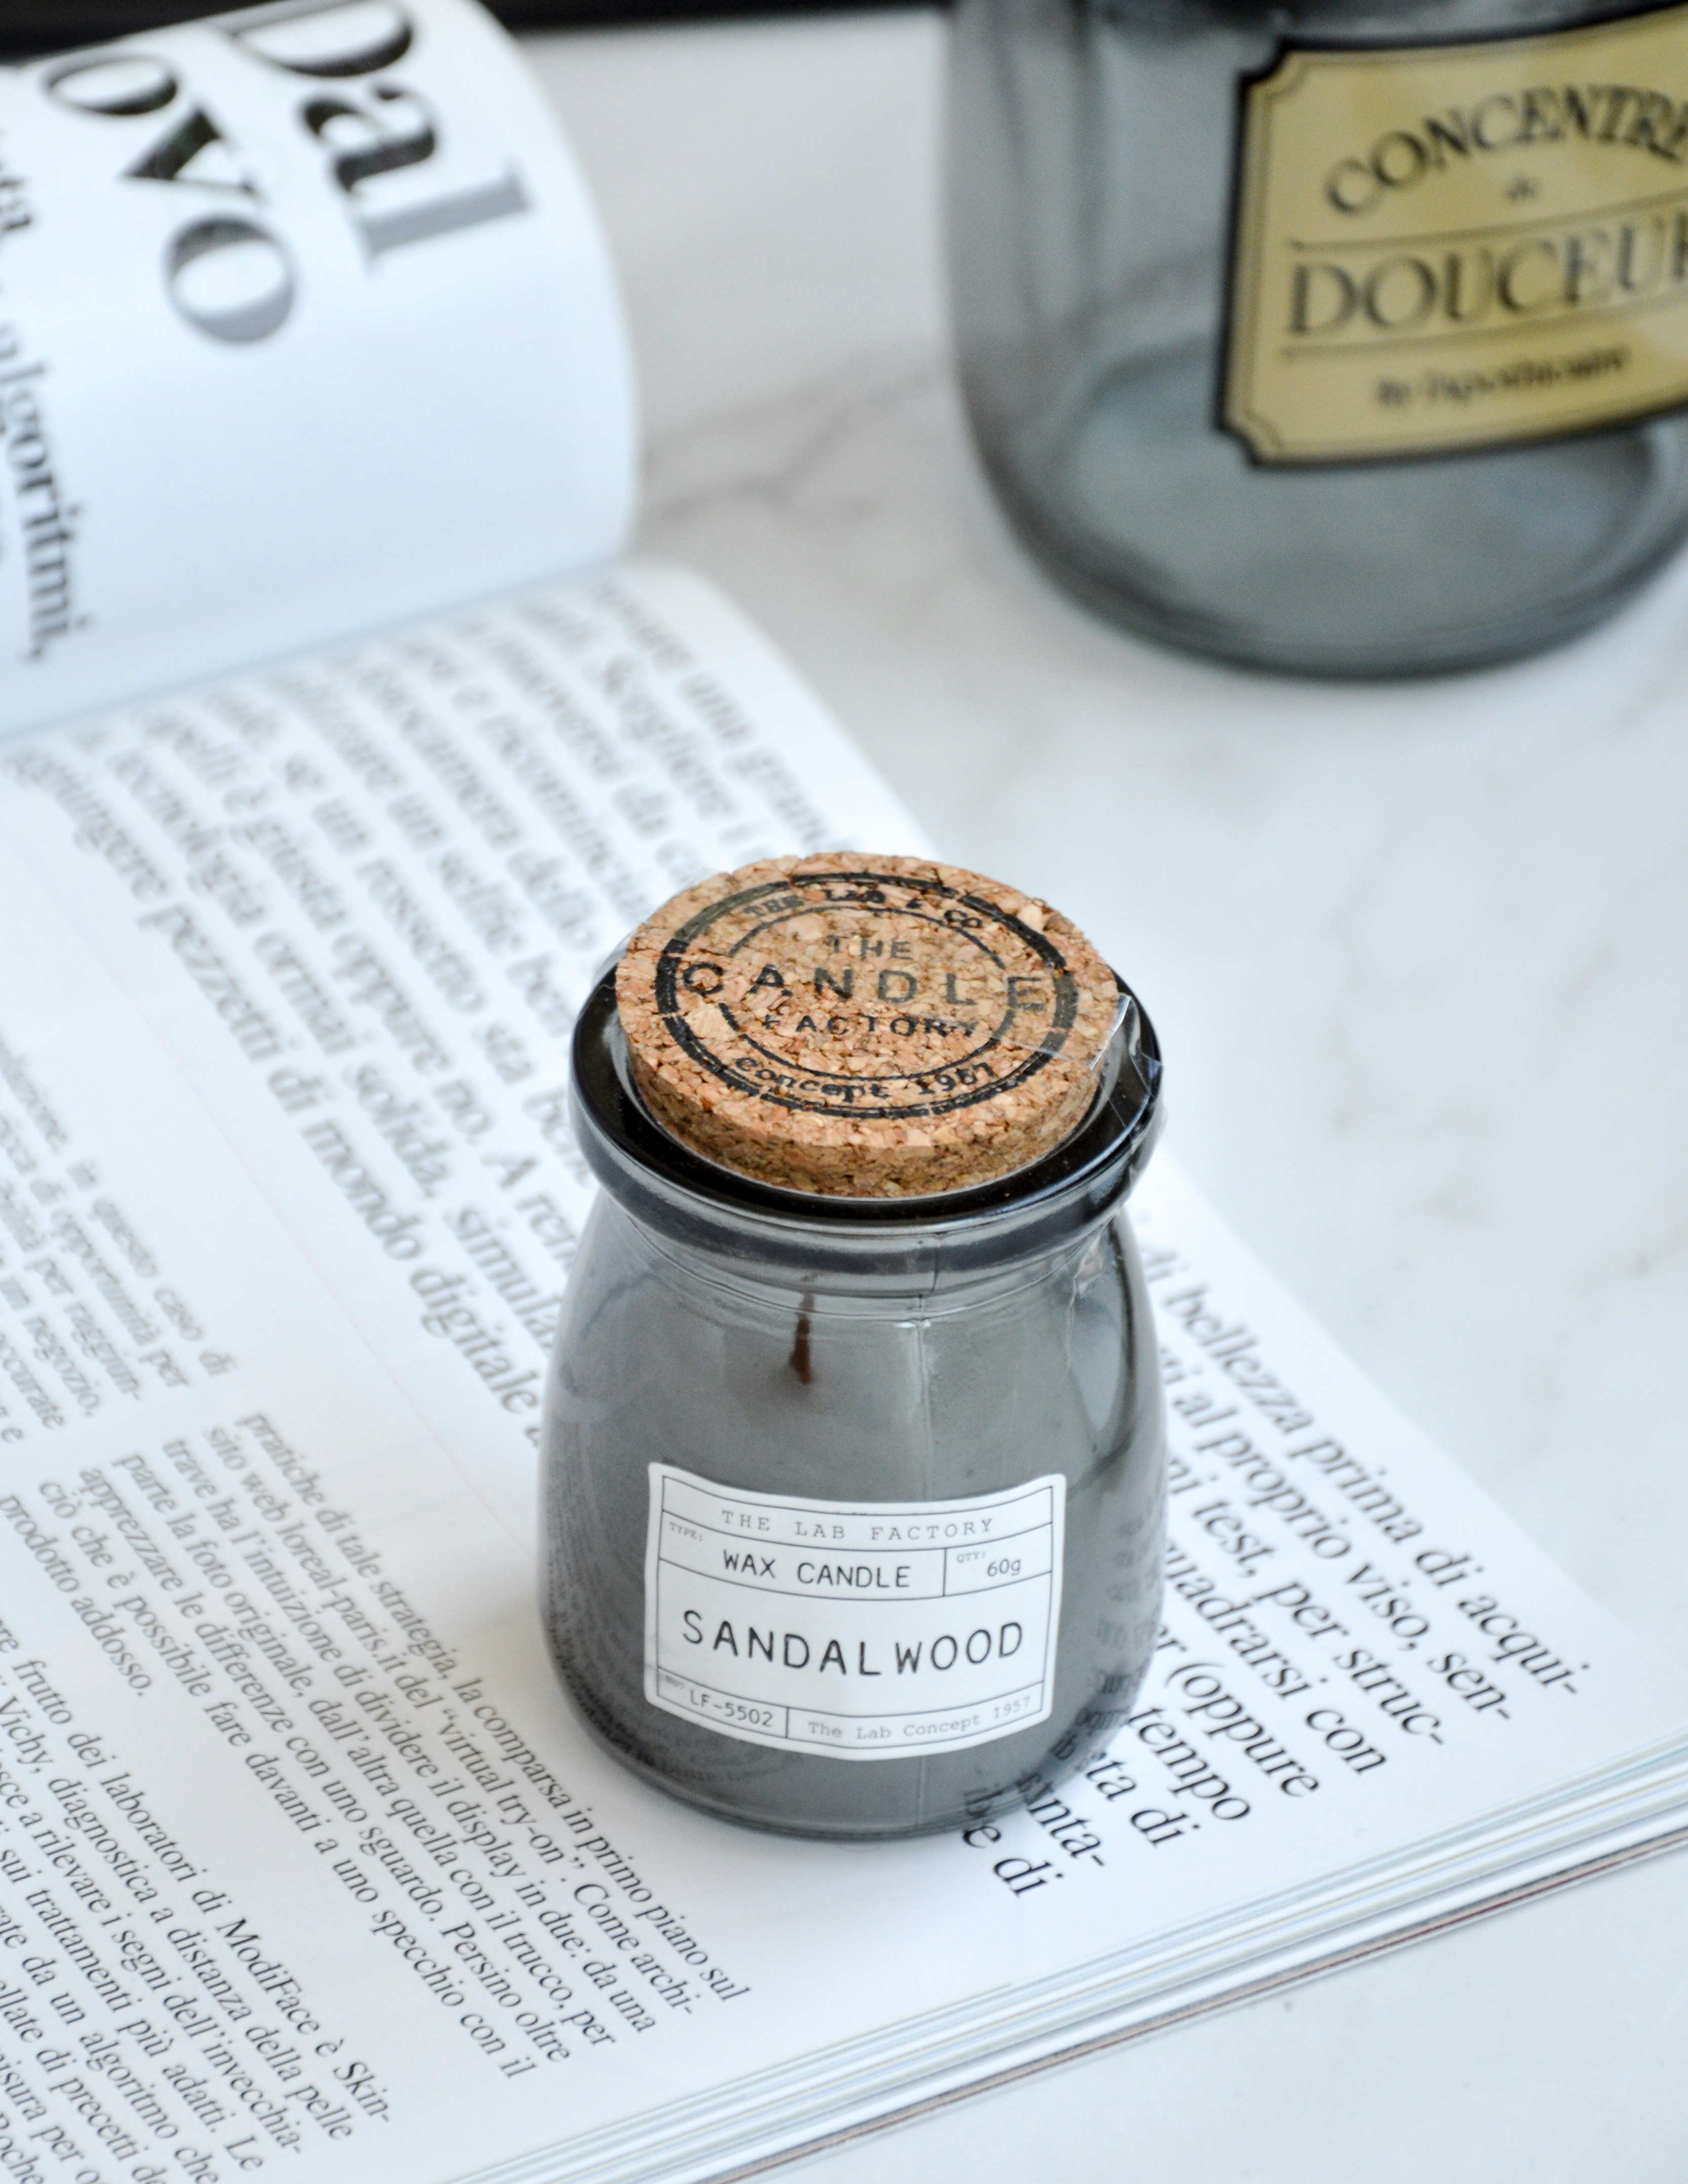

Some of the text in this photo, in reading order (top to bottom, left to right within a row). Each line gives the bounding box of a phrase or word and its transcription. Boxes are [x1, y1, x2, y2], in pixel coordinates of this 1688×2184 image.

[1322, 84, 1688, 215] CONCENTR
[827, 935, 911, 960] THE
[683, 962, 1044, 1010] CANDLE
[764, 1015, 978, 1037] FACTORY
[917, 1062, 997, 1095] 1957
[1171, 1392, 1240, 1429] al
[110, 1452, 178, 1514] parte
[161, 1437, 218, 1498] trave
[1162, 1284, 1314, 1436] bellezza
[1285, 1437, 1423, 1545] prima
[1413, 1549, 1484, 1588] di
[1456, 1594, 1590, 1694] acqui-
[1192, 1430, 1352, 1560] proprio
[164, 1511, 197, 1540] la
[204, 1496, 242, 1532] ha
[669, 1522, 704, 1542] TYPE:
[721, 1509, 993, 1541] THE LAB FACTORY
[183, 1539, 233, 1588] foto
[723, 1549, 911, 1588] WAX CANDLE
[956, 1551, 986, 1564] QTY:
[986, 1558, 1022, 1577] 60g
[1, 1493, 80, 1593] prodotto
[69, 1596, 152, 1697] addosso.
[1190, 1498, 1276, 1577] test,
[1246, 1580, 1349, 1639] per
[1332, 1648, 1444, 1745] struc-
[1345, 1561, 1430, 1651] viso,
[223, 1591, 313, 1698] originale,
[682, 1609, 1023, 1676] SANDALWOOD
[1164, 1545, 1328, 1700] uadrarsi
[1304, 1708, 1387, 1775] con
[233, 1411, 751, 2001] pratiche di tale strategia, la comparsa in primo piano sul
[332, 1664, 373, 1688] di
[1426, 1652, 1511, 1720] sen-
[202, 1425, 248, 1471] sito
[239, 1471, 292, 1522] web
[274, 1520, 408, 1673] loreal-paris.it
[393, 1674, 444, 1709] del
[573, 1882, 640, 1950] Come
[630, 1953, 701, 2014] archi-
[354, 1690, 439, 1777] dividere
[689, 1689, 773, 1727] LF-5502
[808, 1696, 1032, 1740] The Lab Concept 1957
[1166, 1662, 1320, 1796] (oppure
[37, 1481, 537, 2078] ciò che è possibile fare davanti a uno specchio con il
[77, 1467, 570, 2061] apprezzare le differenze con uno sguardo. Persino oltre
[428, 1777, 466, 1797] il
[1128, 1707, 1251, 1820] tempo
[18, 1812, 43, 1828] a
[385, 1798, 458, 1867] quella
[446, 1800, 526, 1877] display
[1129, 1809, 1201, 1847] di
[11, 1659, 389, 2122] frutto dei laboratori di ModiFace è Skin-
[31, 1829, 111, 1912] rilevare
[448, 1869, 495, 1911] con
[514, 1879, 547, 1908] in
[992, 1857, 1065, 1899] di
[1, 1695, 352, 2139] Vichy, diagnostica a distanza della pelle
[100, 1912, 132, 1927] i
[484, 1910, 522, 1931] il
[538, 1910, 591, 1958] due:
[110, 1929, 182, 1991] segni
[502, 1931, 572, 2009] trucco,
[582, 1961, 617, 1990] da
[1, 1849, 42, 1883] sui
[25, 1888, 142, 2012] trattamenti
[115, 2018, 174, 2057] più
[161, 2064, 236, 2133] adatti.
[223, 2134, 264, 2171] Le
[558, 2009, 615, 2046] per
[608, 1989, 655, 2033] una
[20, 1956, 57, 1987] da
[49, 1992, 86, 2025] un
[78, 2032, 179, 2139] algoritmo
[173, 2147, 219, 2183] che
[35, 2048, 77, 2073] di
[1, 2056, 47, 2121] isura
[28, 2124, 85, 2162] per
[48, 2076, 149, 2161] precetti
